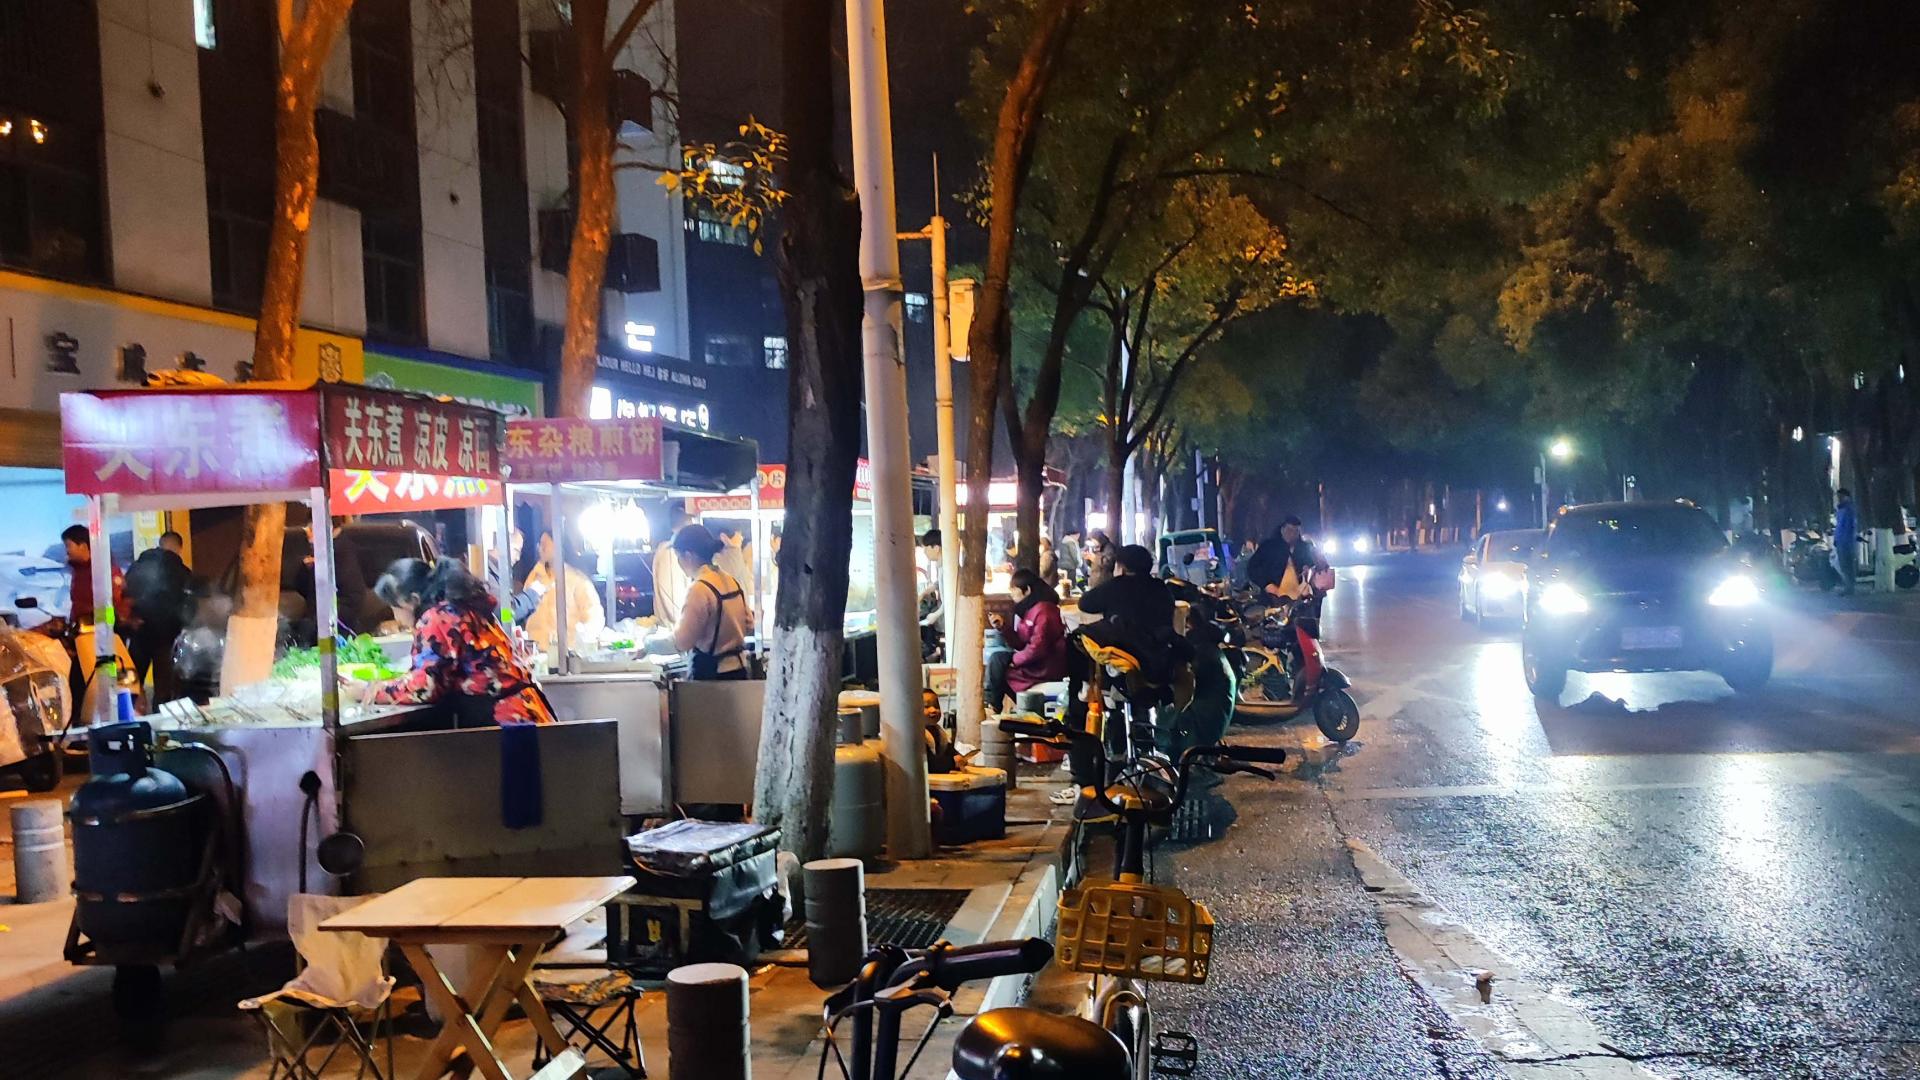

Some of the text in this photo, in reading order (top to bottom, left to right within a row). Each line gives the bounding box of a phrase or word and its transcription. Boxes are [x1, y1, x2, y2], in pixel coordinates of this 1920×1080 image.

[344, 397, 404, 467] 关东煮
[413, 406, 449, 472] 凉皮
